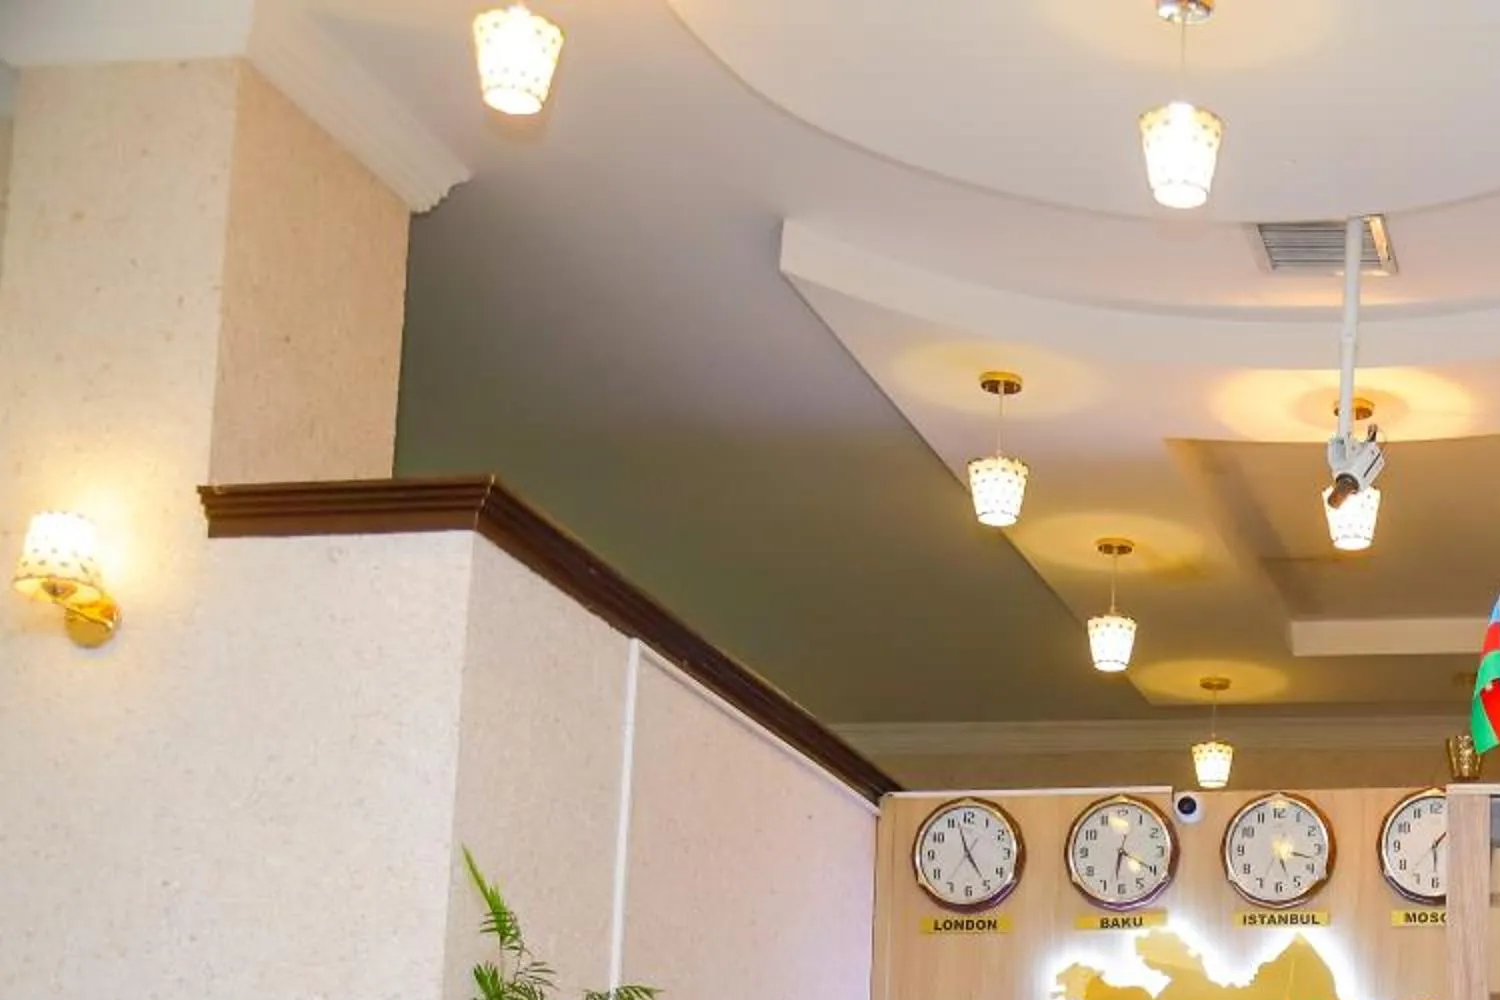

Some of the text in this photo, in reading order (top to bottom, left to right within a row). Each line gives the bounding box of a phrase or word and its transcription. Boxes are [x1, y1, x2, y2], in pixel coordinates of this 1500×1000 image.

[1274, 808, 1286, 819] 12
[1414, 809, 1421, 818] 11
[1430, 803, 1442, 814] 12
[947, 818, 955, 828] 11
[964, 812, 975, 825] 12
[986, 818, 989, 828] 1
[1101, 816, 1108, 826] 11
[1139, 814, 1143, 825] 1
[1257, 812, 1265, 824] 11
[997, 830, 1005, 841] 2
[1086, 830, 1097, 840] 10
[1150, 828, 1159, 839] 2
[1242, 826, 1255, 838] 10
[1308, 826, 1316, 837] 2
[933, 832, 944, 843] 10
[1237, 844, 1245, 856] 9
[1393, 841, 1400, 852] 9
[928, 850, 935, 861] 9
[1004, 848, 1011, 860] 3
[1080, 847, 1089, 858] 9
[996, 867, 1003, 878] 4
[1086, 866, 1095, 876] 8
[1149, 865, 1157, 876] 4
[1244, 864, 1251, 874] 8
[1306, 864, 1314, 874] 4
[947, 882, 954, 892] 7
[983, 880, 990, 890] 5
[1136, 878, 1144, 889] 5
[1256, 878, 1263, 888] 7
[1275, 882, 1283, 893] 6
[1293, 876, 1301, 888] 5
[1432, 878, 1439, 888] 6
[965, 886, 972, 897] 6
[1118, 884, 1126, 894] 6
[1100, 917, 1143, 929] BAKU
[1243, 914, 1320, 925] ISTANBUL
[933, 920, 997, 931] LONDON
